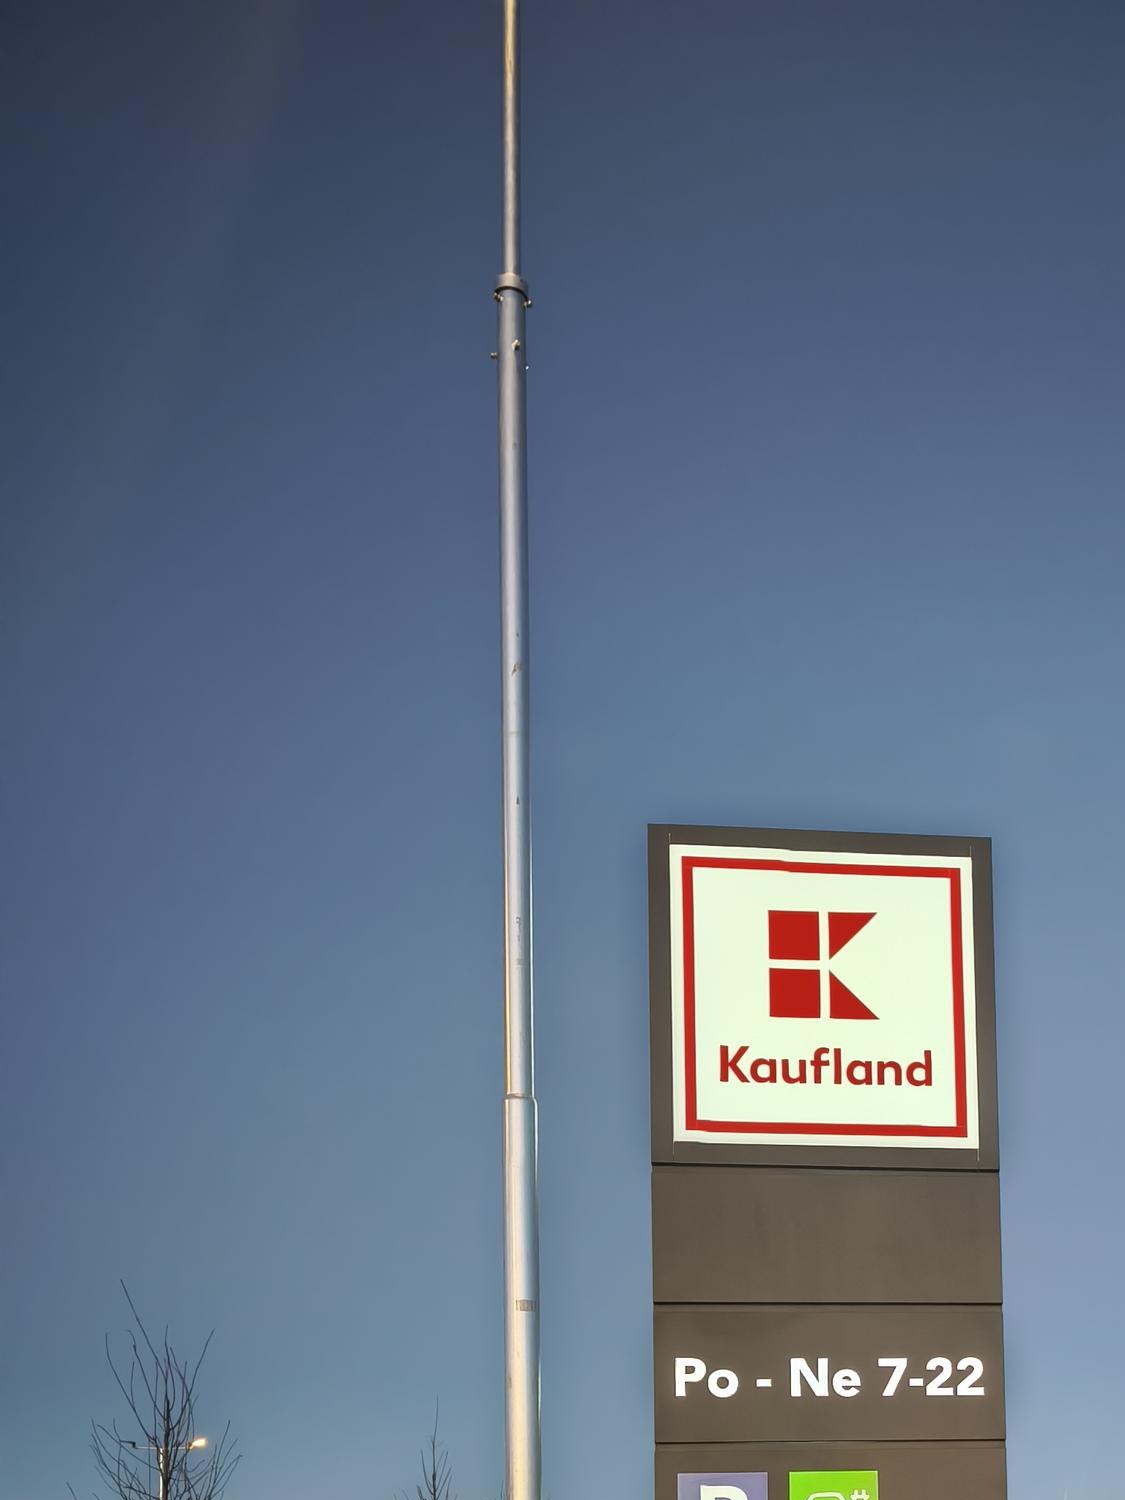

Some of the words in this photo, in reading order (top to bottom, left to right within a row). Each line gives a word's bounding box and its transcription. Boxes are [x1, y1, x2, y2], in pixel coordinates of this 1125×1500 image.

[767, 909, 880, 1020] K
[719, 1044, 933, 1087] Kaufland
[674, 1357, 739, 1398] Po
[790, 1357, 862, 1398] Ne
[877, 1356, 985, 1397] 7-22
